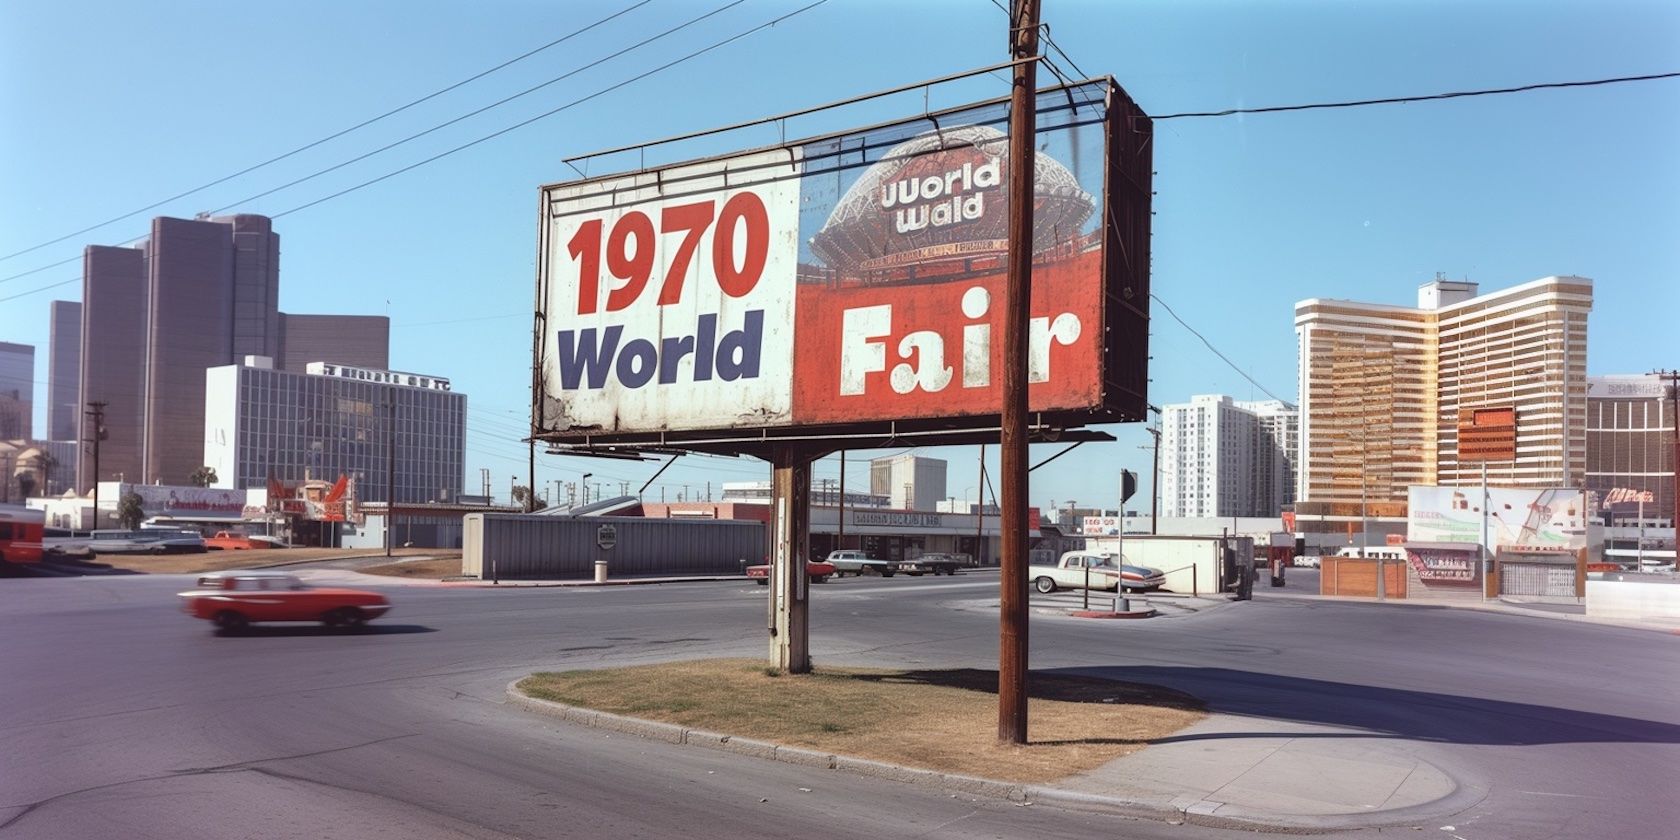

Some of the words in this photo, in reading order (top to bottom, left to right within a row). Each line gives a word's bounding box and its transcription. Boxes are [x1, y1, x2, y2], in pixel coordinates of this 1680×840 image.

[567, 191, 769, 315] 1970
[558, 309, 765, 391] World
[840, 286, 1082, 396] Fair
